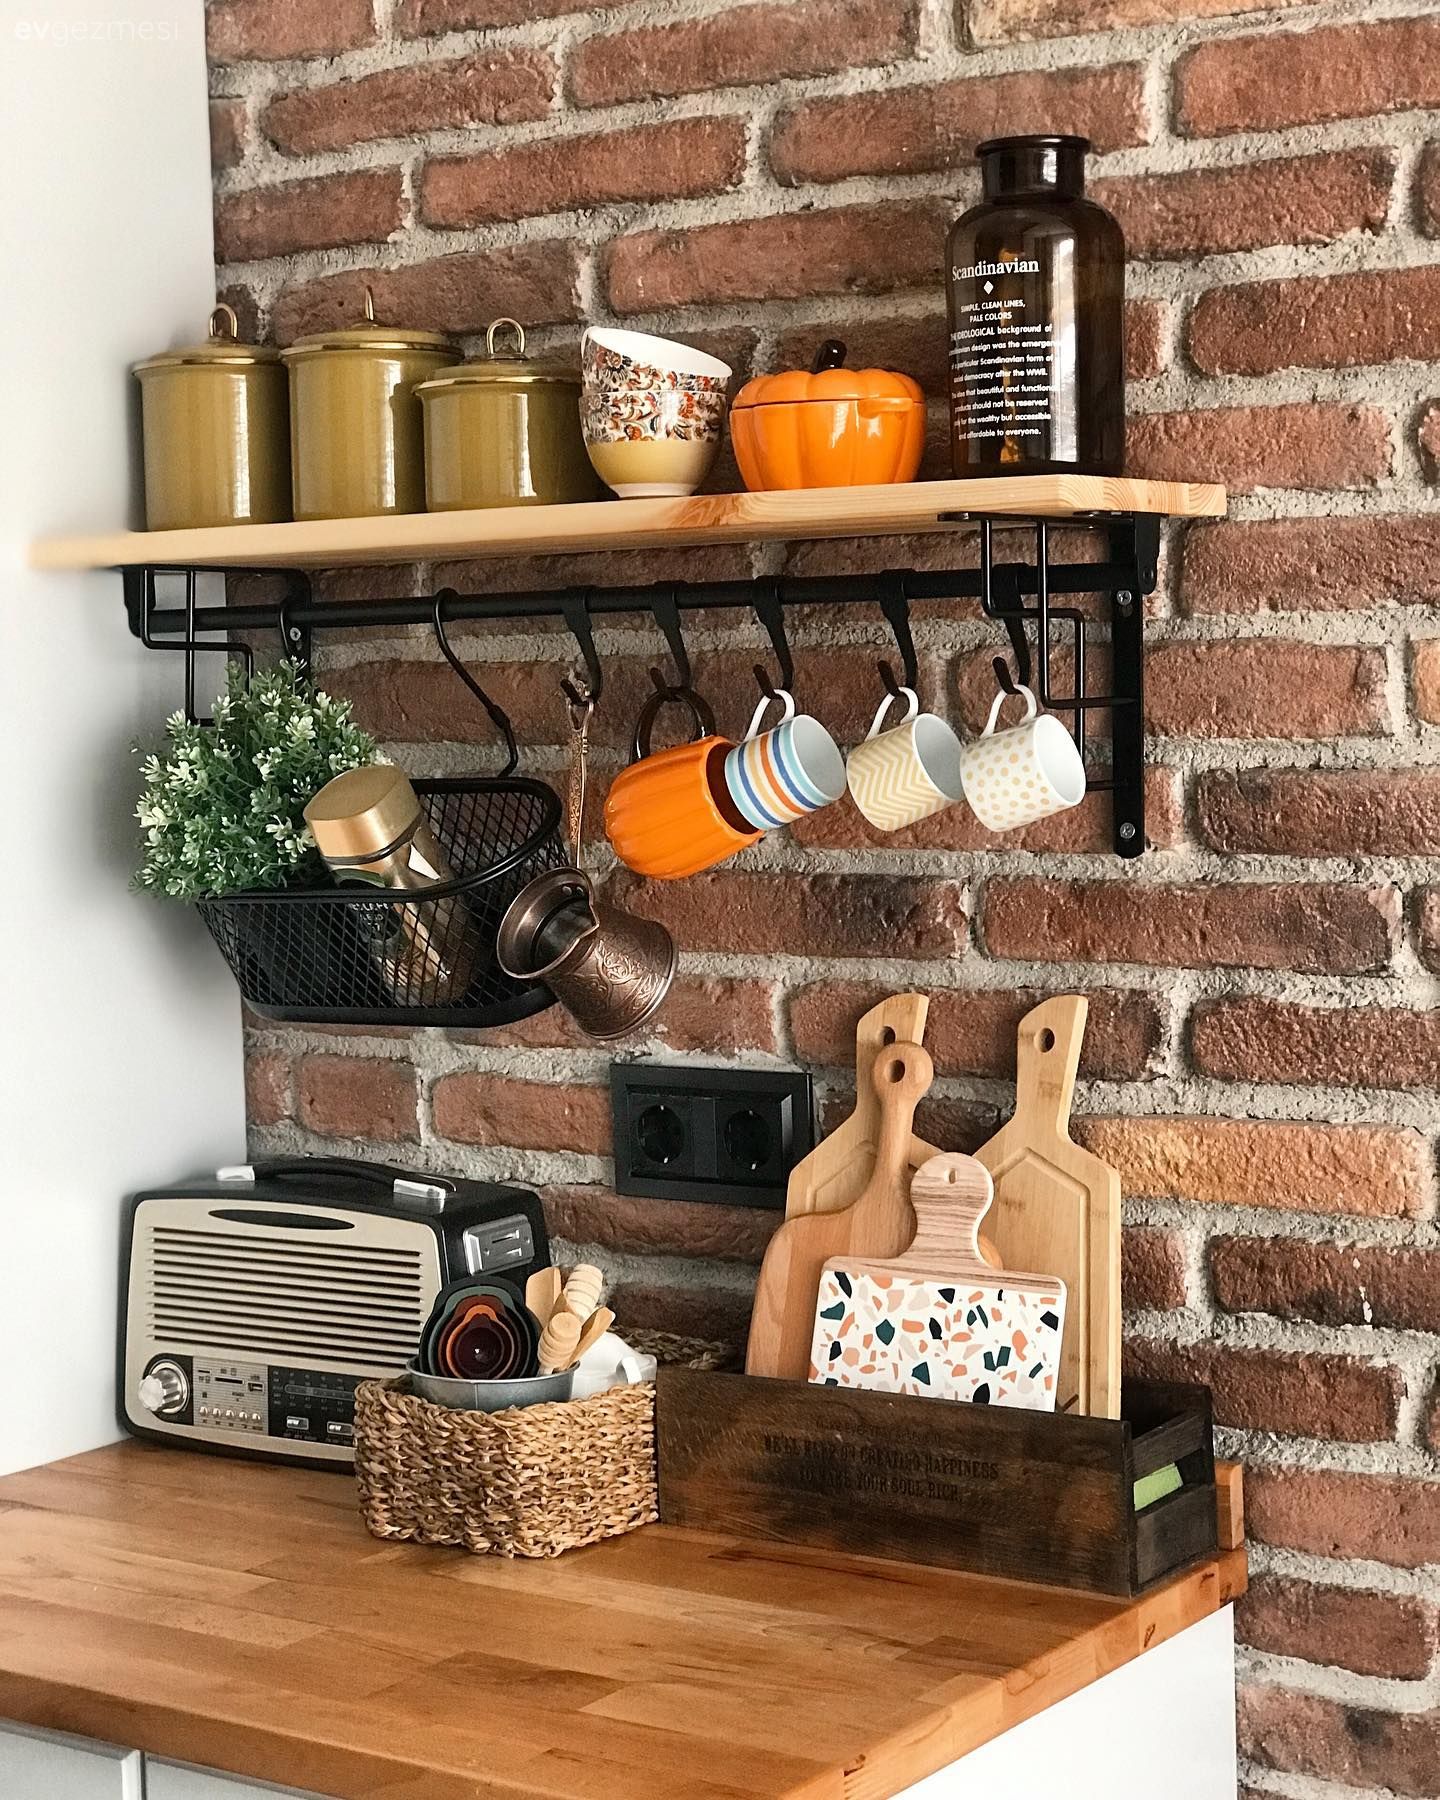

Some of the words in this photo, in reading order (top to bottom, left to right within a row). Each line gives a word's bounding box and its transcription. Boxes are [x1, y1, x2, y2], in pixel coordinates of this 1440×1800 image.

[952, 257, 1040, 281] Scandinavian
[981, 301, 1003, 310] CLEAN
[1004, 299, 1026, 308] LINES,
[969, 314, 984, 323] PALE
[984, 312, 1013, 321] COLORS
[997, 324, 1042, 335] background
[1044, 323, 1053, 332] of
[971, 343, 991, 352] design
[992, 341, 1006, 349] was
[1007, 340, 1020, 348] the
[980, 355, 1025, 366] Scandinavian
[1026, 354, 1044, 363] form
[1045, 354, 1054, 362] of
[964, 371, 995, 381] democracy
[995, 369, 1011, 378] after
[1012, 368, 1025, 377] the
[976, 386, 1004, 395] beautiful
[1005, 384, 1020, 393] and
[972, 400, 992, 410] should
[992, 400, 1005, 409] not
[1005, 398, 1015, 407] be
[1016, 398, 1048, 407] reserved
[976, 414, 1001, 424] wealthy
[1000, 413, 1013, 422] but
[1014, 411, 1052, 420] accessible
[967, 429, 996, 440] affordable
[996, 428, 1004, 437] to
[1004, 428, 1042, 437] everyone.
[924, 1455, 1000, 1481] HAPPINESS
